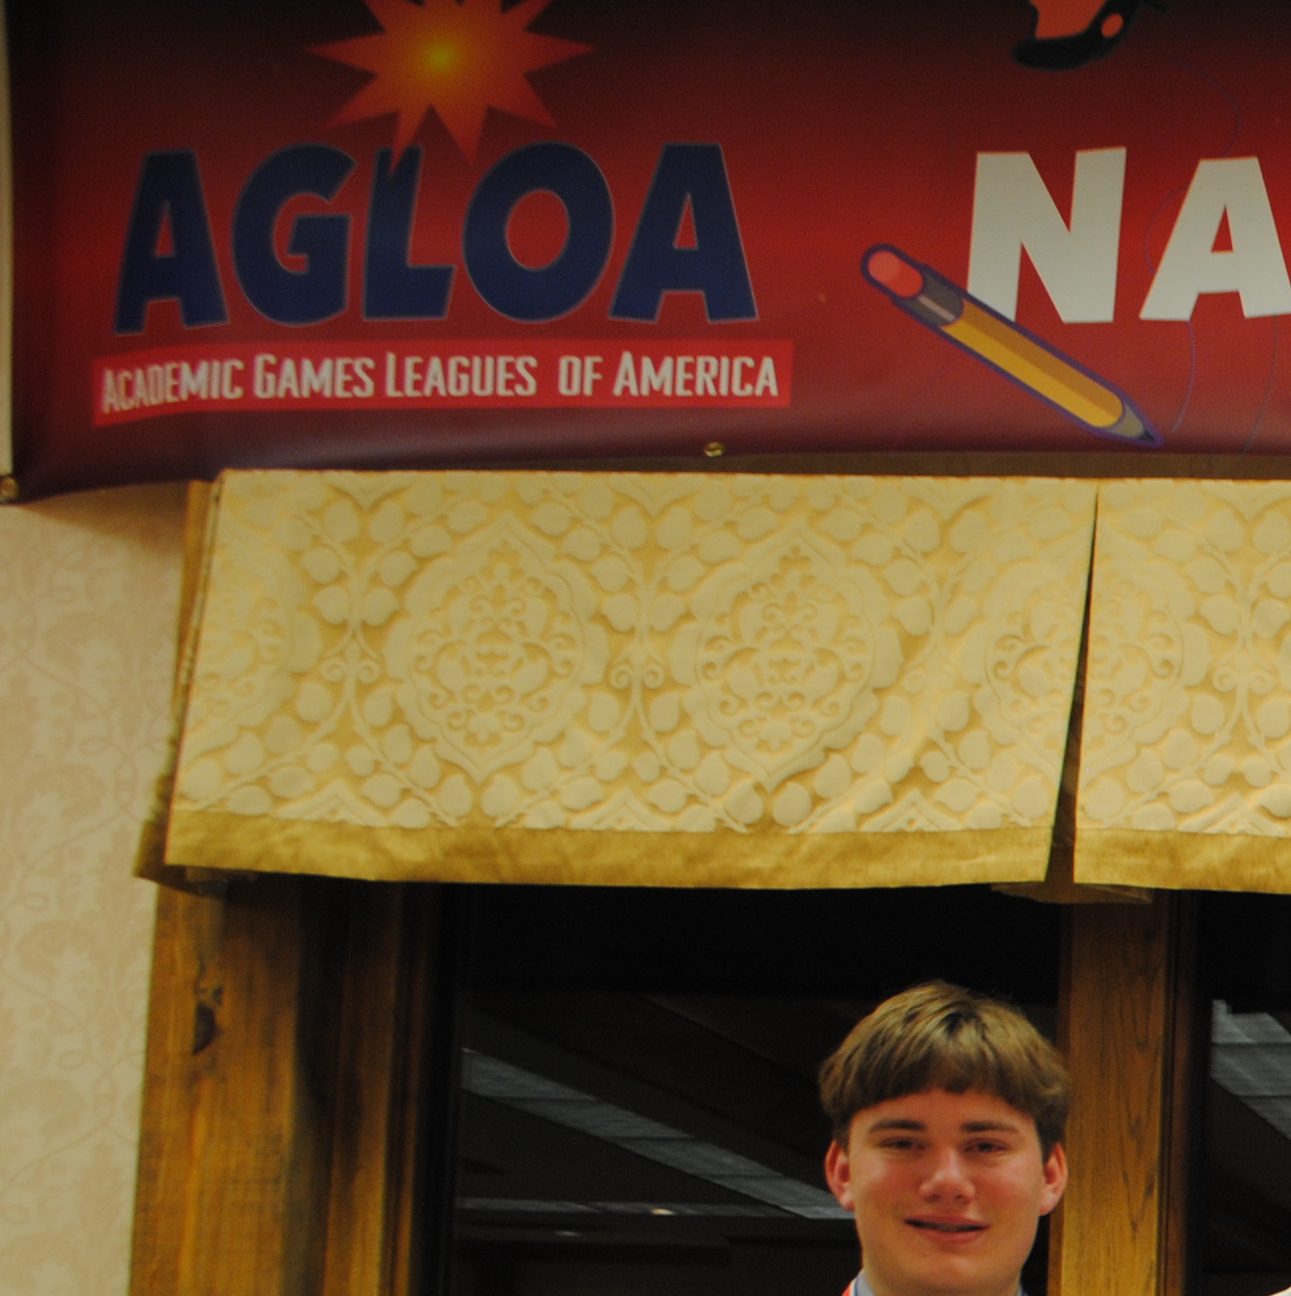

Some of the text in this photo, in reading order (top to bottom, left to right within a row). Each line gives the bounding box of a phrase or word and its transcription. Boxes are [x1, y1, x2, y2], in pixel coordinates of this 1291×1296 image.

[113, 142, 760, 335] AGLOA
[101, 351, 779, 415] ACADEMIC GAMES LEAGUES OF AMERICA
